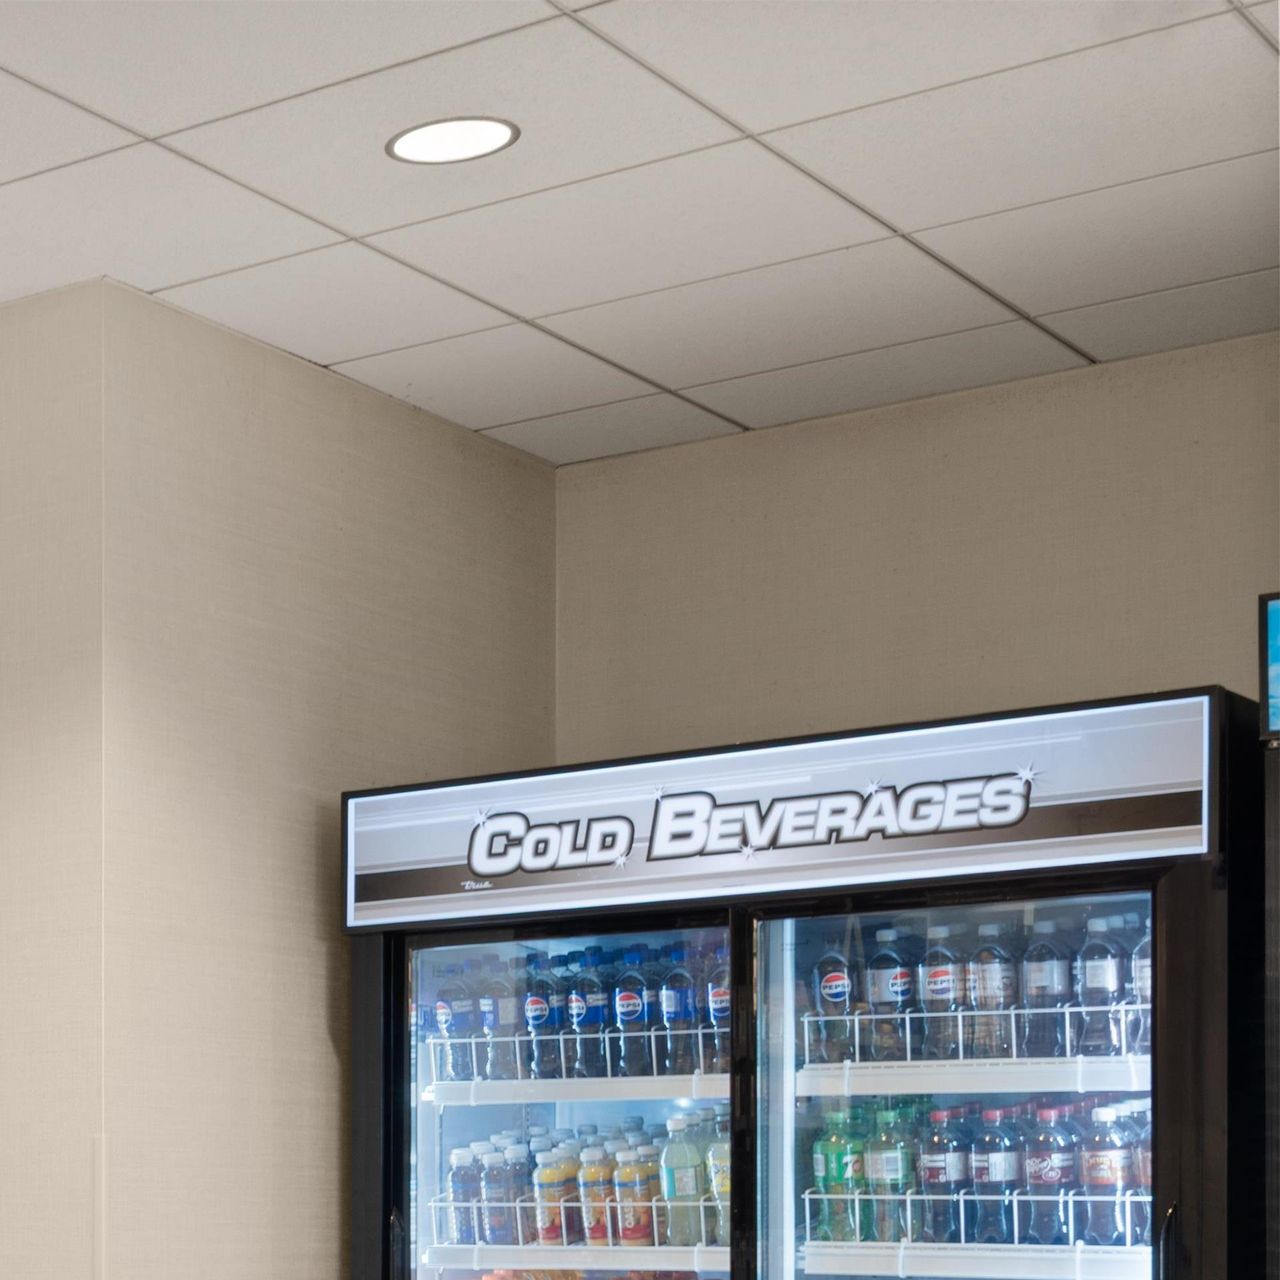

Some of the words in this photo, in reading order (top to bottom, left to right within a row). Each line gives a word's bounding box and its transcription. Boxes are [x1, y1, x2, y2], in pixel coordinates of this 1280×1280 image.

[470, 811, 632, 877] COLD
[649, 771, 1032, 861] BEVERAGES
[822, 982, 851, 992] PEPSI
[927, 978, 956, 988] PEPSI
